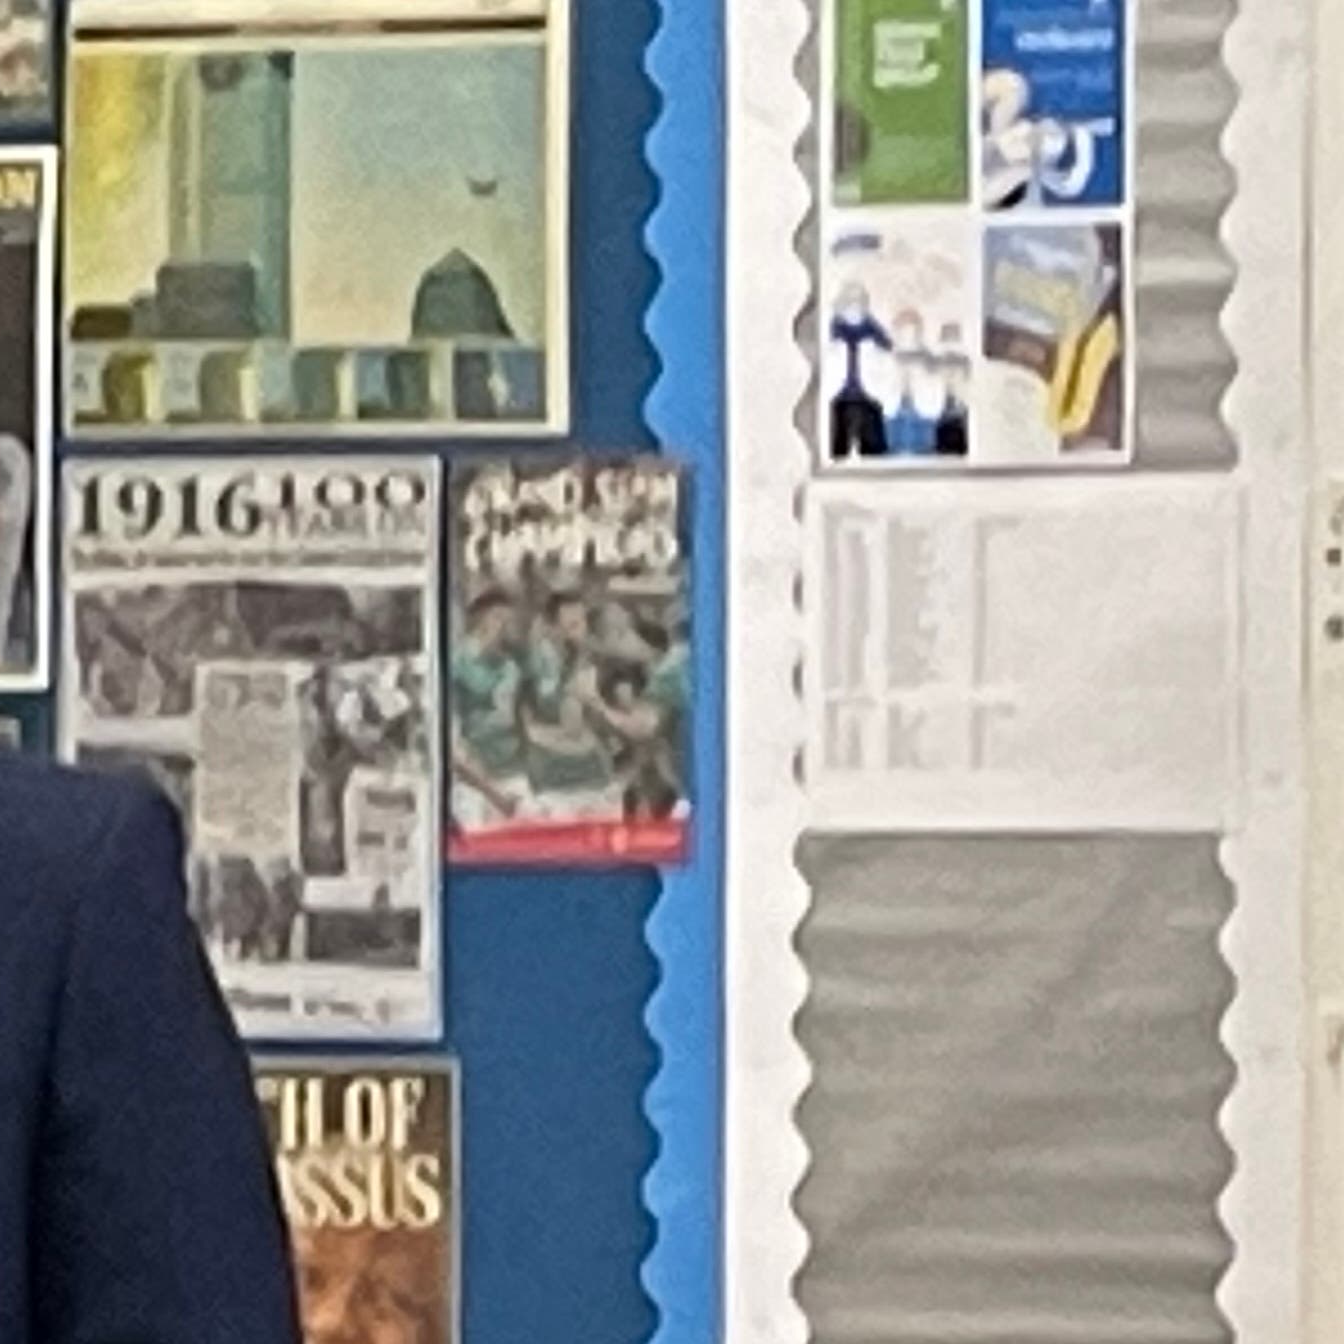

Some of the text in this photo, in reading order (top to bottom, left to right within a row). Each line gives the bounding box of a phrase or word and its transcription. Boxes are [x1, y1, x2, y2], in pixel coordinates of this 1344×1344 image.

[74, 470, 261, 540] 1916
[342, 1075, 426, 1153] OF
[276, 1151, 442, 1232] SSUS
